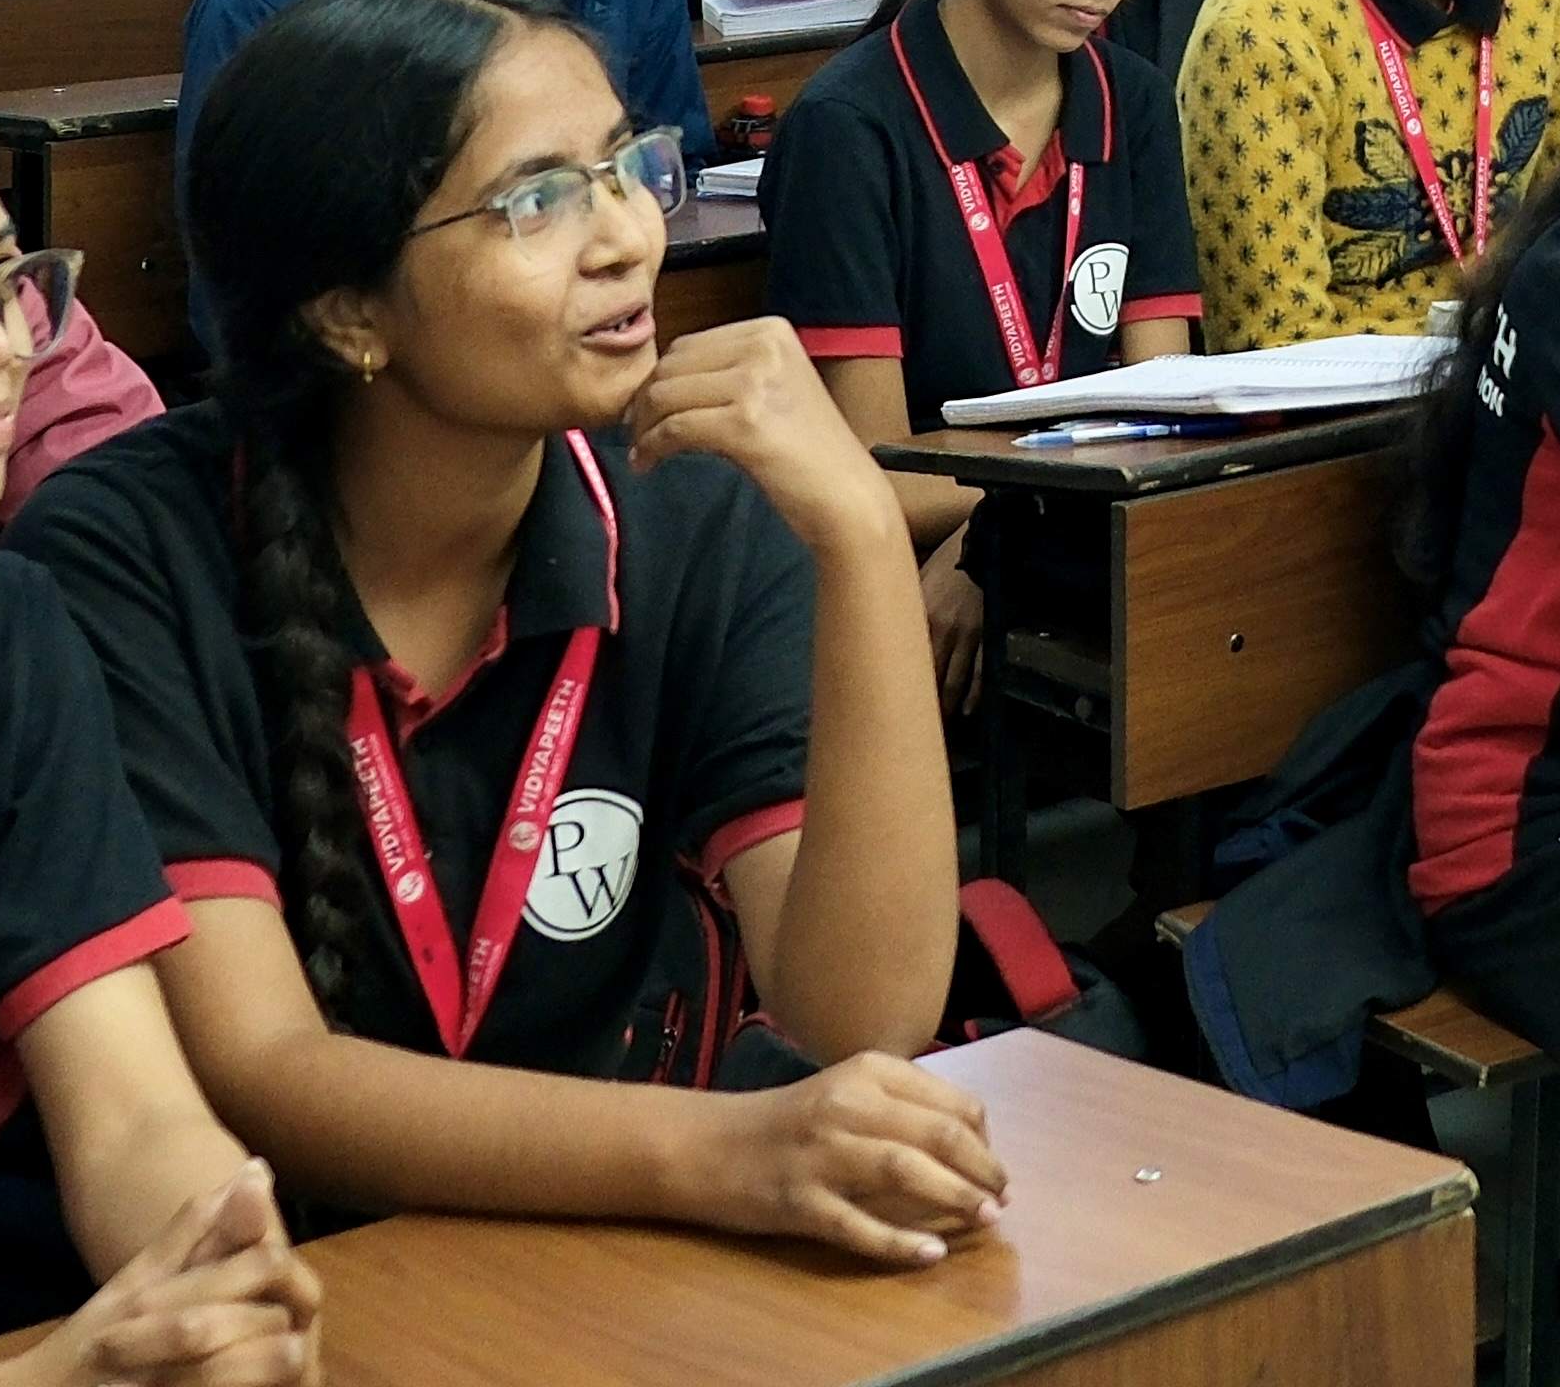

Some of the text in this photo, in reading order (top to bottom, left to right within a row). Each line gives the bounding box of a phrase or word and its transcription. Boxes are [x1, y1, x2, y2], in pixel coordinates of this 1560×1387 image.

[1378, 41, 1410, 119] VIDYAPEETH
[951, 164, 976, 213] VIDYAP
[991, 283, 1026, 367] VIDYAPEETH
[517, 677, 577, 815] VIDYAPEETH
[350, 735, 407, 874] VIDYAPEETH
